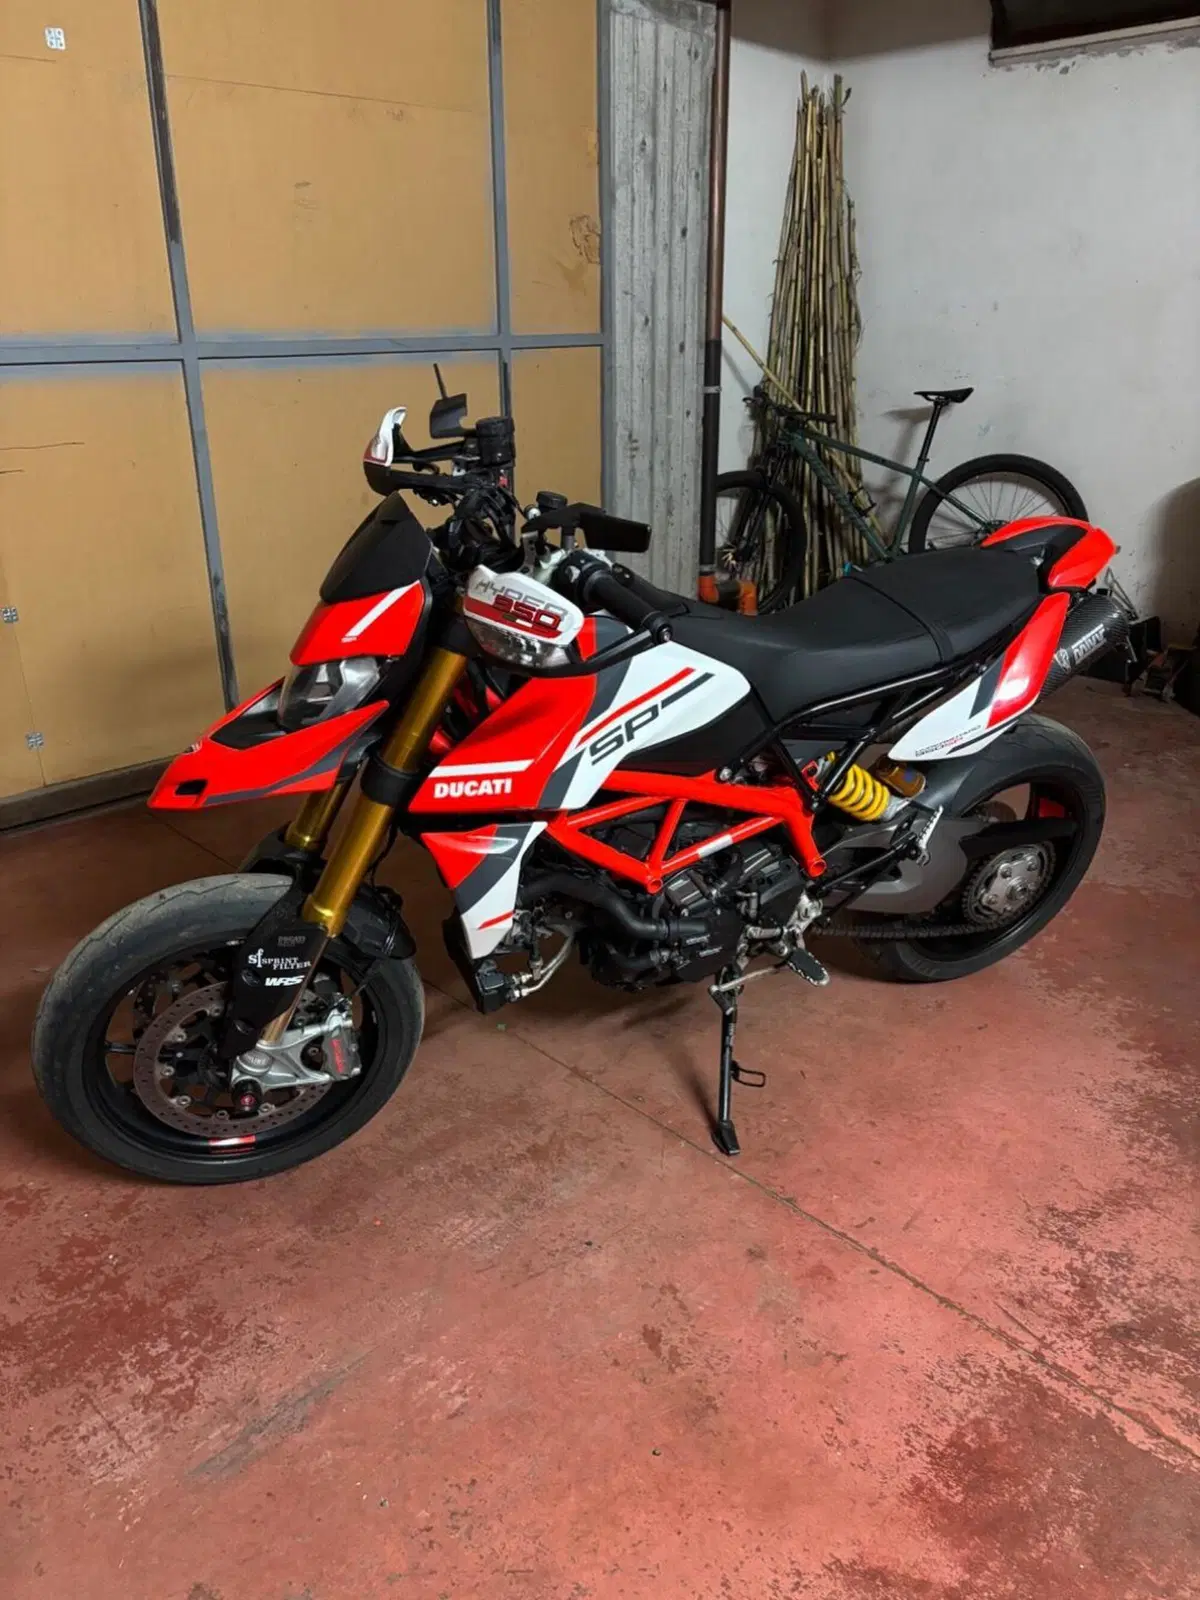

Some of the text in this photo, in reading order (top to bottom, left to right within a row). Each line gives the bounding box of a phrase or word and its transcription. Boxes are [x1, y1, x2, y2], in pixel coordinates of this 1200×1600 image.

[492, 593, 562, 631] 950
[589, 702, 660, 766] SP
[433, 777, 513, 799] DUCATI
[273, 960, 312, 970] FILTER
[264, 975, 305, 987] WRS
